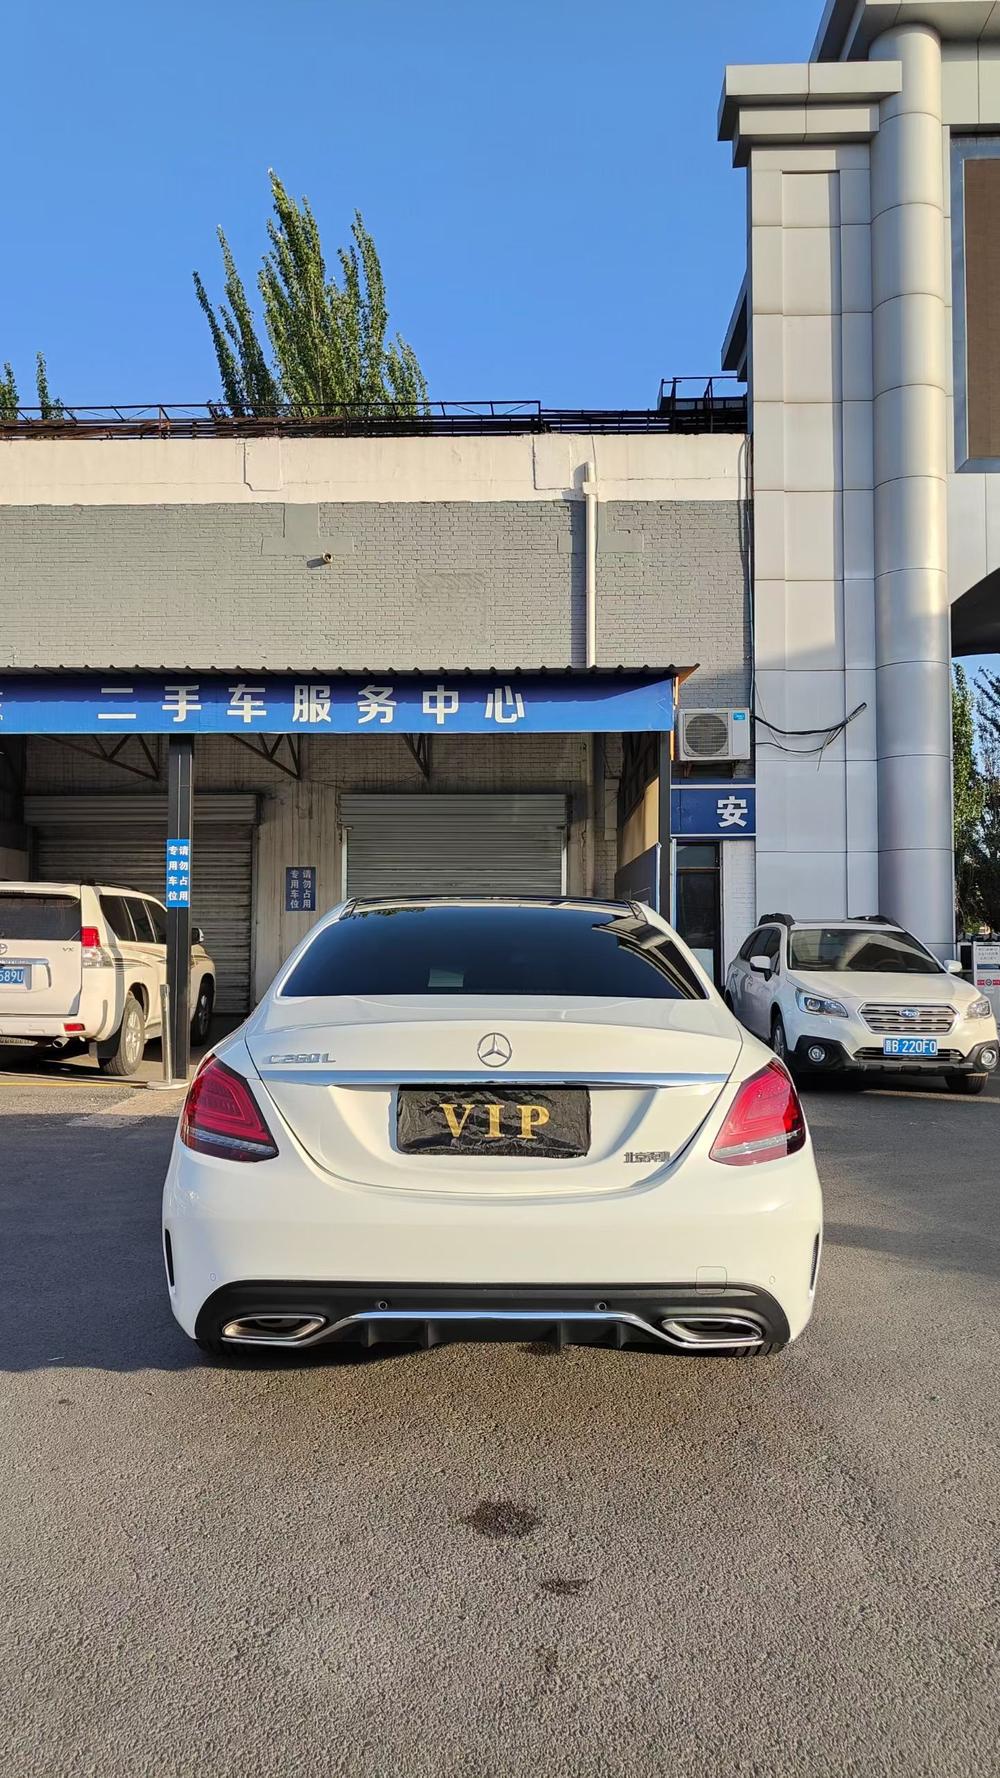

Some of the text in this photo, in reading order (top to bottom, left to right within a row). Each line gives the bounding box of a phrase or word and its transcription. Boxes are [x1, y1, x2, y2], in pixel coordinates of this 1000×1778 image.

[98, 684, 525, 724] 二手车服务中心
[716, 796, 748, 828] 安
[168, 846, 178, 900] 专用车位
[179, 846, 188, 900] 请勿占用
[290, 870, 299, 908] 专用车位
[303, 870, 311, 908] 请勿占用
[440, 1103, 551, 1140] VIP
